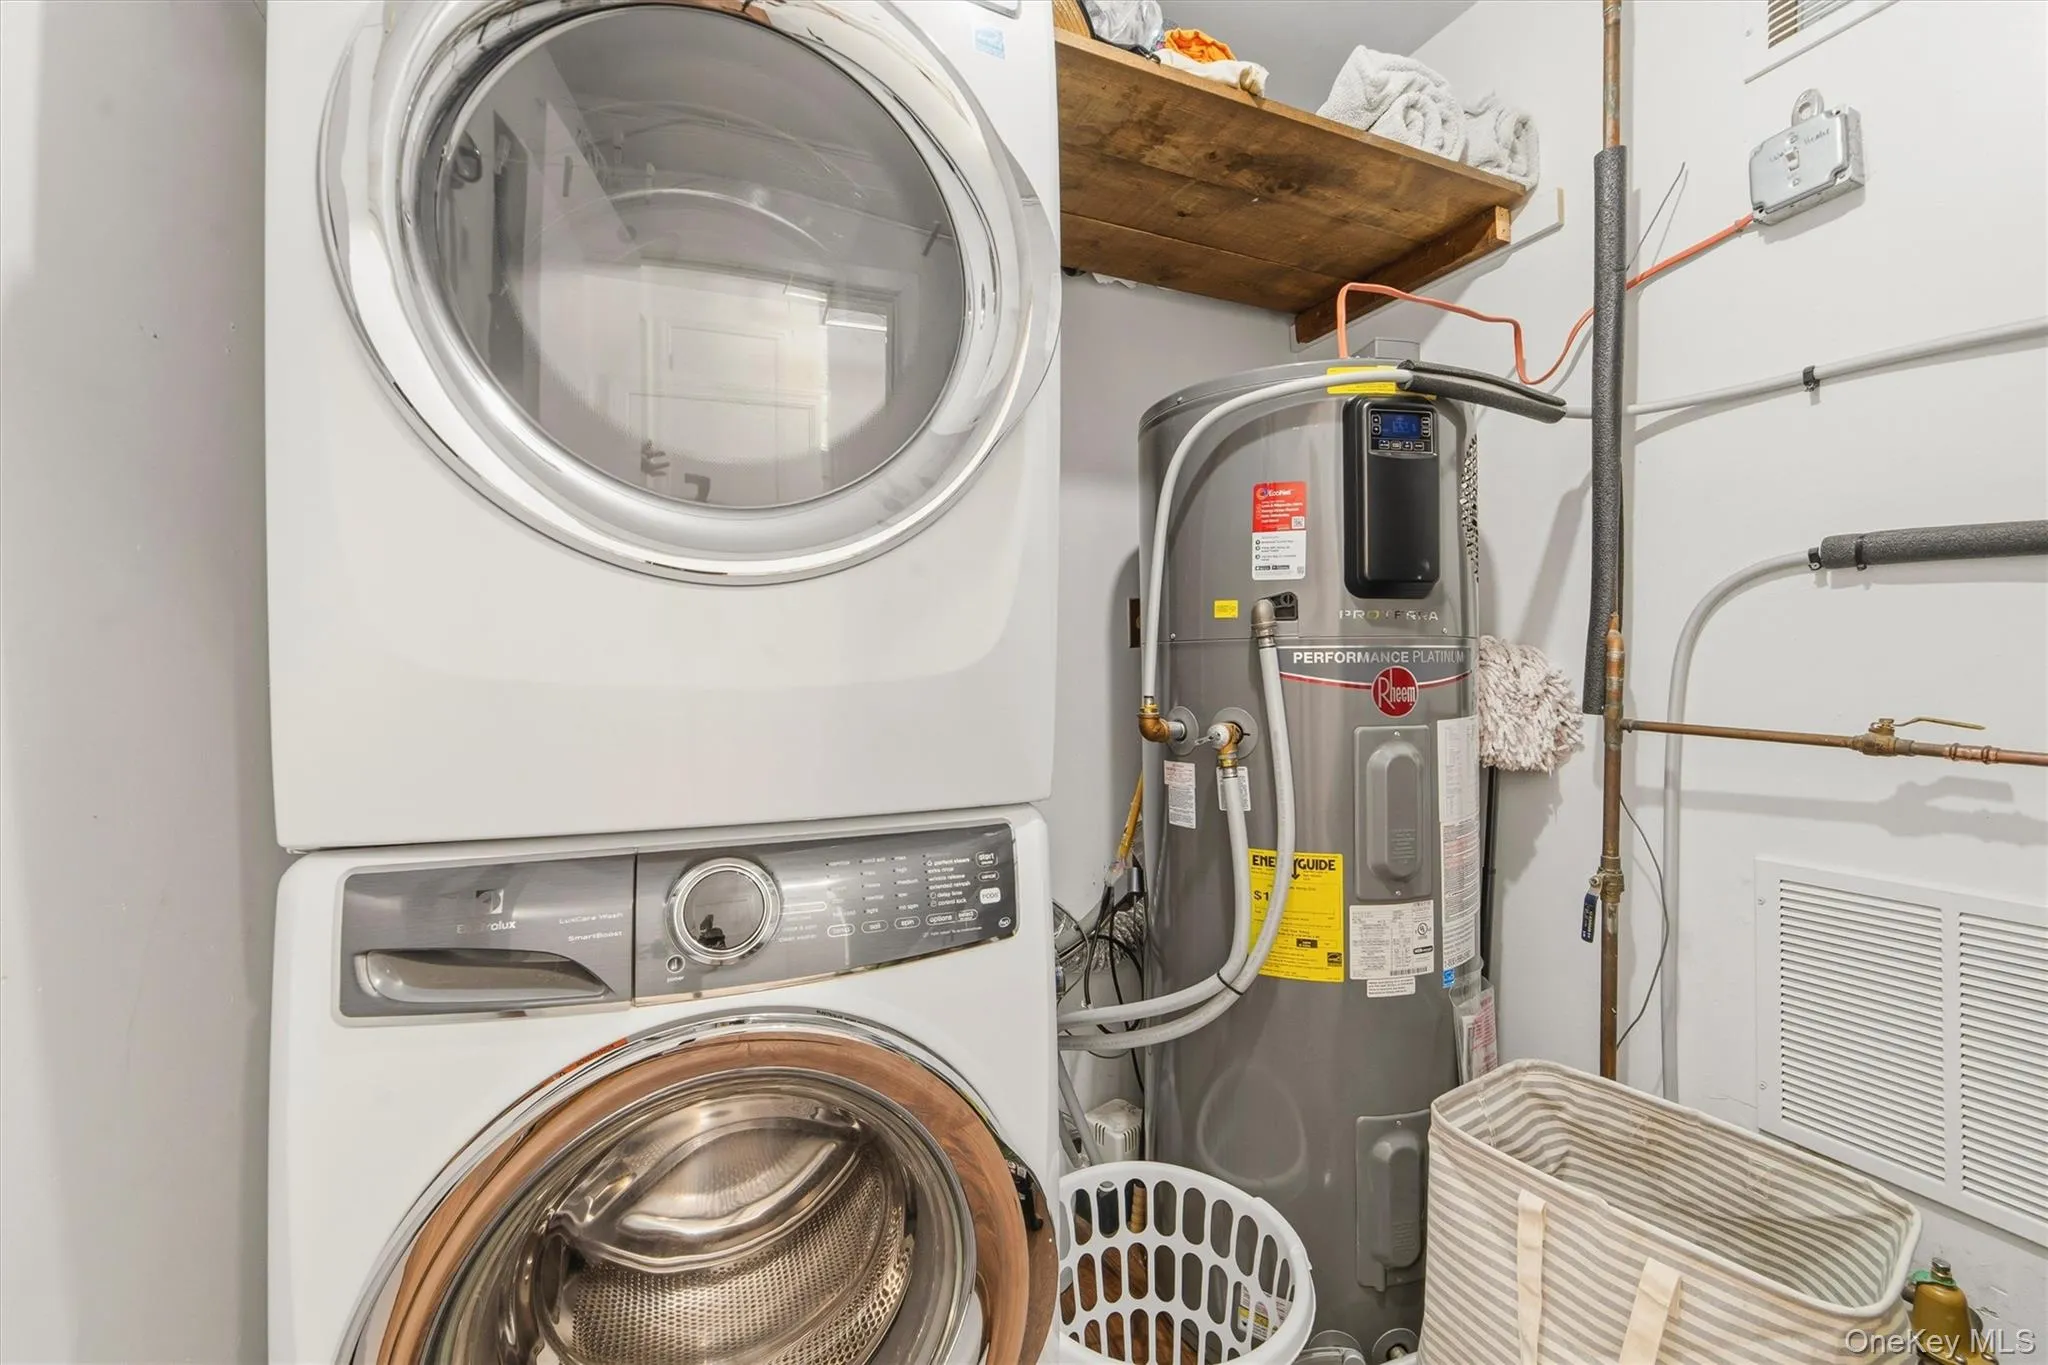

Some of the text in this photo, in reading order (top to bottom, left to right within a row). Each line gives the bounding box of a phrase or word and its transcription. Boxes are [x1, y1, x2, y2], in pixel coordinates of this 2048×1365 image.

[1293, 650, 1464, 664] PERFORMANCE PLATINUM
[1377, 668, 1416, 709] Rheem
[558, 911, 624, 925] LuxCare Wash
[567, 930, 624, 942] SmartBoost
